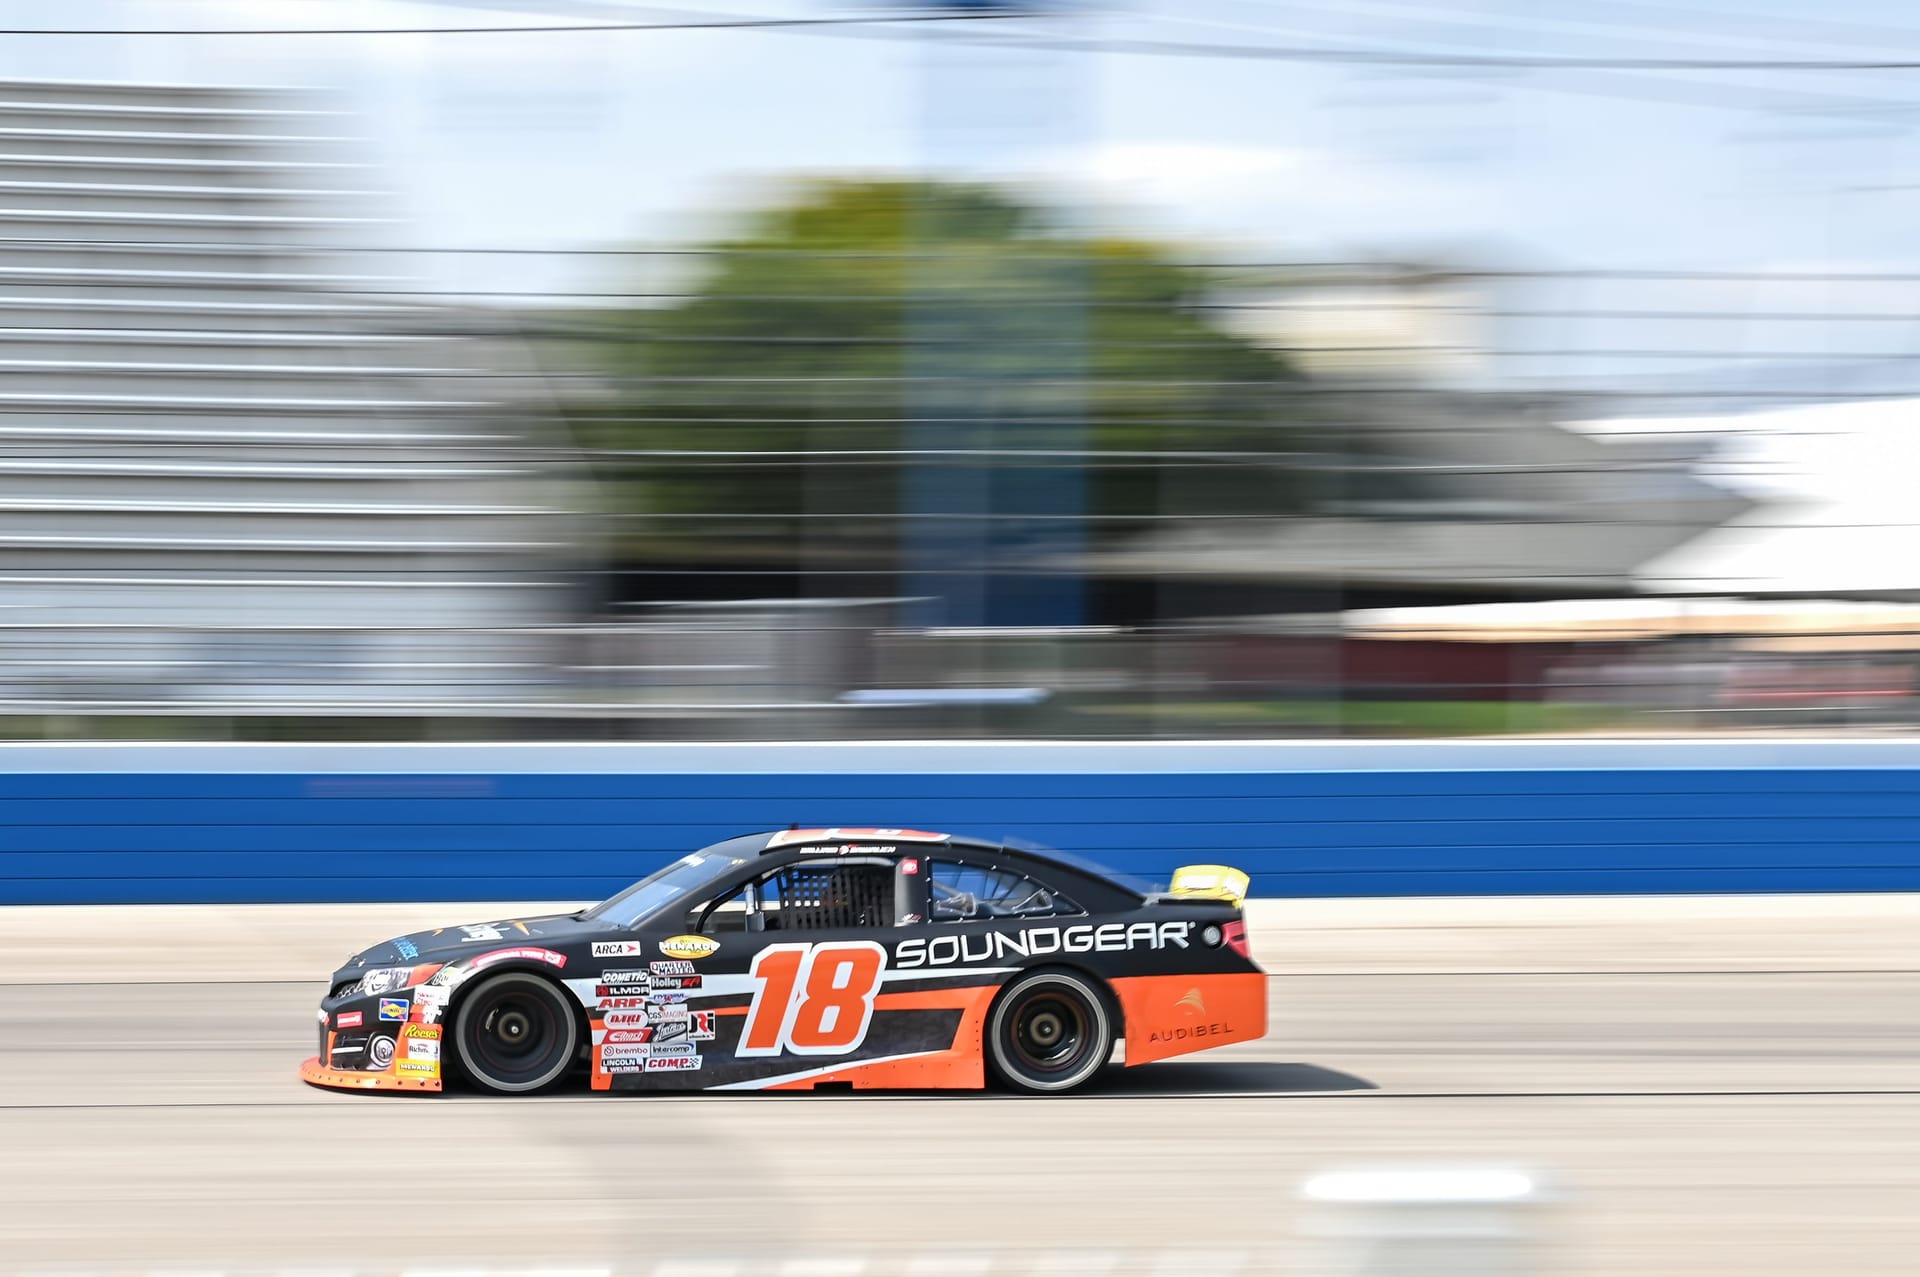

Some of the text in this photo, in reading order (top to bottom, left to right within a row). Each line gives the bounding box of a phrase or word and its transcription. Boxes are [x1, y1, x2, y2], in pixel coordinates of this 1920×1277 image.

[594, 944, 623, 955] ARCA
[896, 921, 1191, 968] SOUNDGEAR
[603, 971, 648, 983] COMETIC
[651, 978, 681, 989] Holley
[609, 986, 650, 995] ILMOR
[599, 998, 644, 1009] ARP
[739, 944, 886, 1054] 18
[1149, 1023, 1236, 1043] AUDIBEL
[615, 1047, 648, 1055] brembo
[652, 1045, 690, 1053] Intercomp
[648, 1057, 689, 1068] COMP
